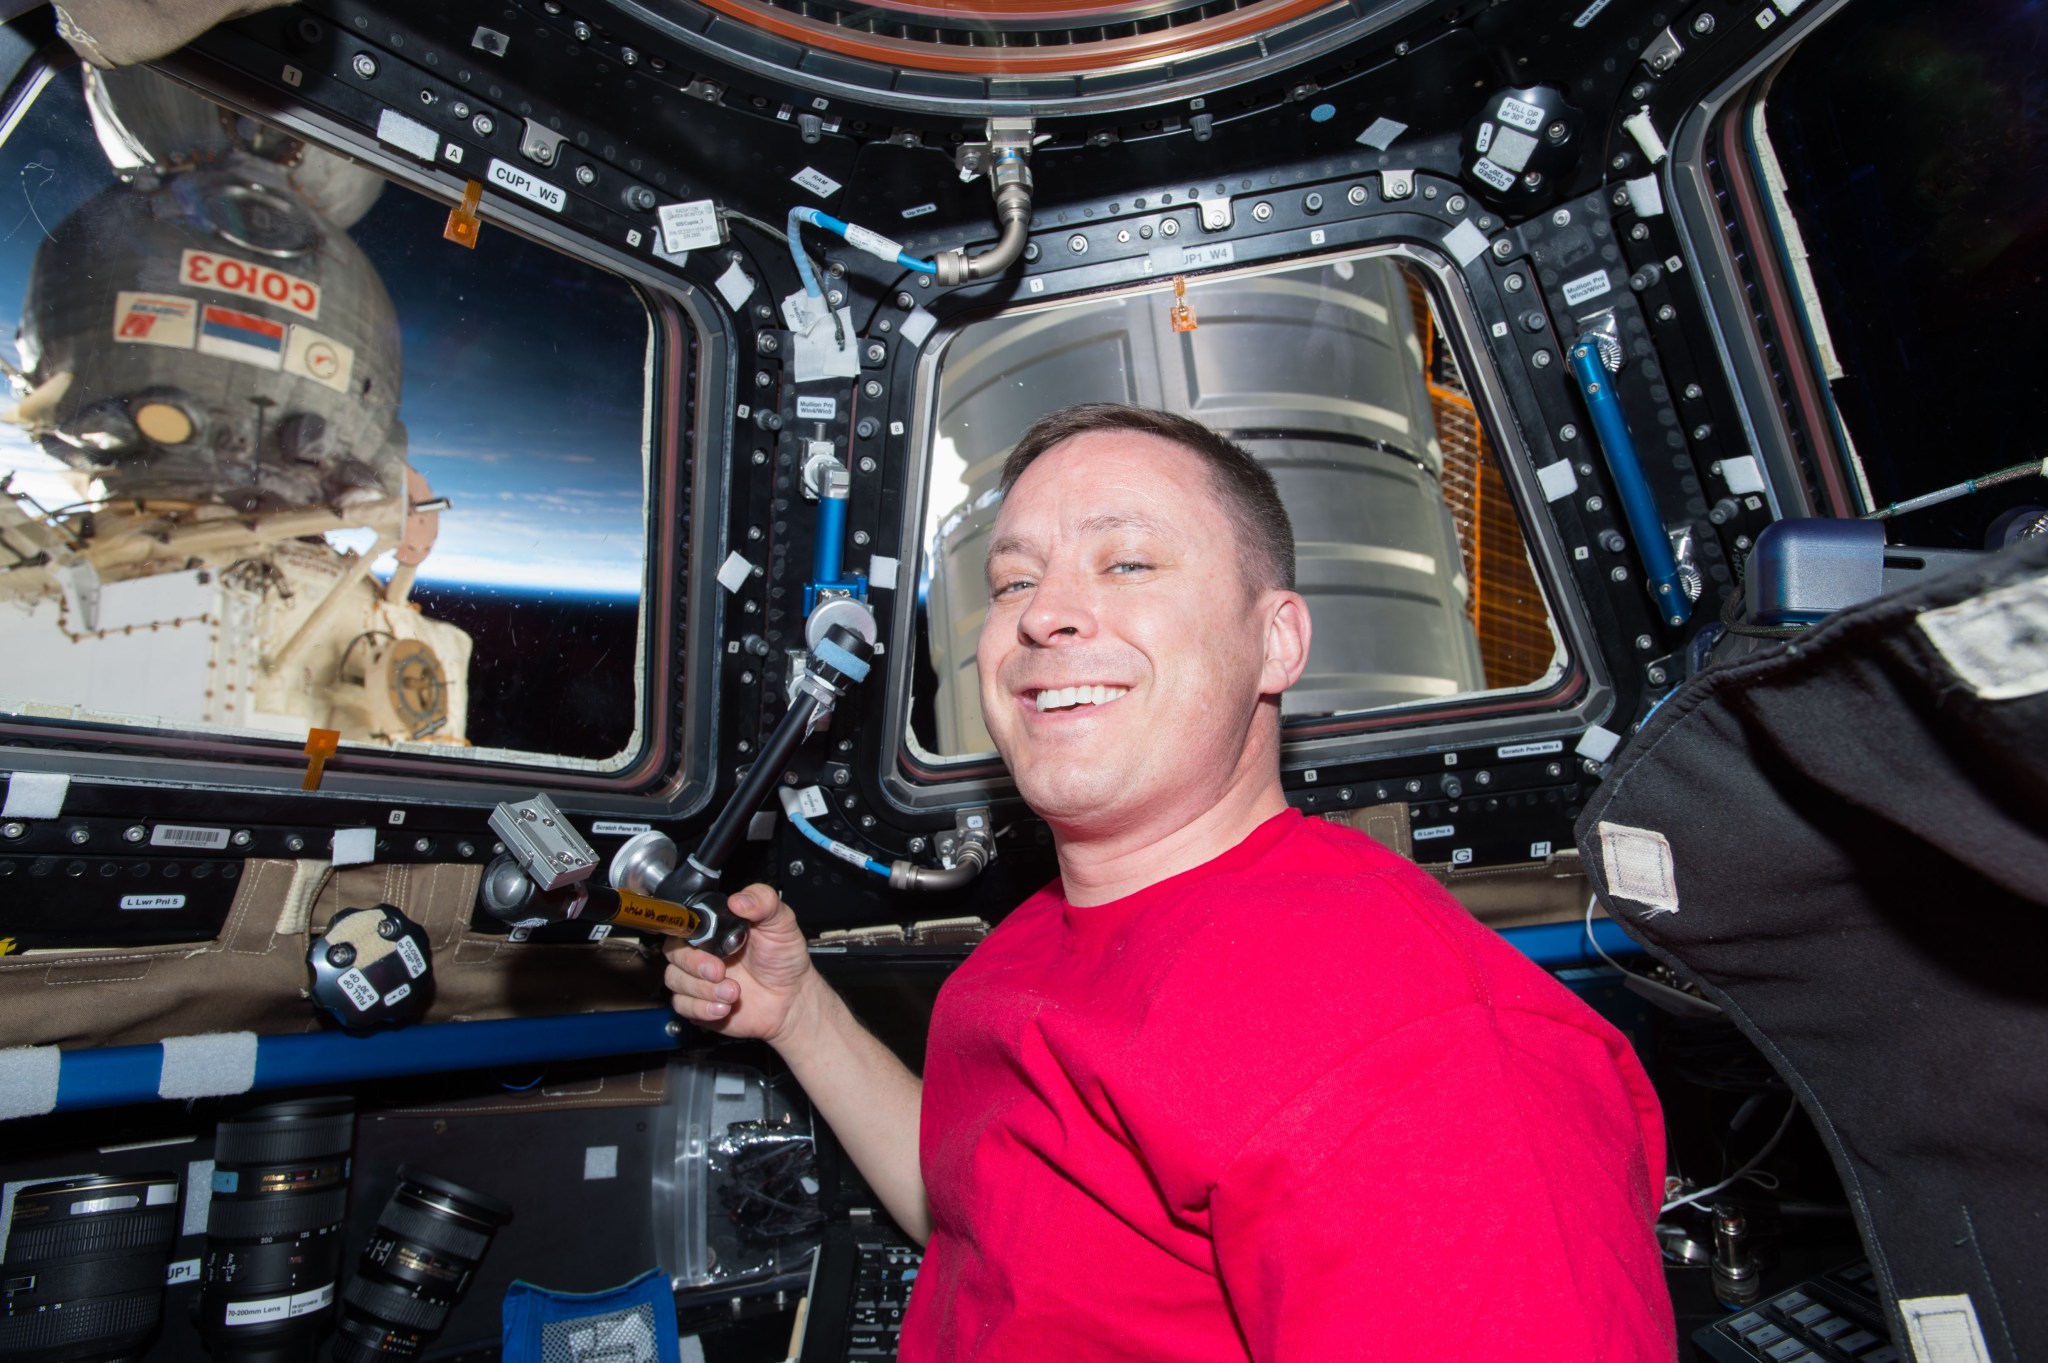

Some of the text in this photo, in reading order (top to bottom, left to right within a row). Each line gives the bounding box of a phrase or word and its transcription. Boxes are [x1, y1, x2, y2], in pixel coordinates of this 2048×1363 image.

[1578, 14, 1590, 23] Up
[288, 70, 296, 81] 1
[1507, 102, 1538, 118] FULL OP
[1524, 118, 1536, 126] OP
[1479, 139, 1486, 148] CL
[450, 148, 458, 159] A
[1478, 161, 1489, 170] OP
[812, 174, 828, 185] RAM
[1478, 168, 1505, 187] CLOSED
[495, 167, 560, 205] CUP1_W5
[798, 176, 828, 194] Cupola_2
[631, 234, 637, 242] 2
[1670, 260, 1678, 268] 8
[188, 254, 316, 312] СОЮЗ
[1566, 276, 1604, 294] Mullion Pnl
[1570, 282, 1606, 300] Win3/Win4
[1496, 326, 1502, 334] 3
[740, 407, 746, 416] 3
[1307, 772, 1314, 780] B
[392, 813, 401, 822] B
[1455, 844, 1548, 862] G H
[511, 925, 606, 940] G H
[405, 940, 423, 968] CLOSED
[412, 964, 420, 975] OP
[349, 973, 360, 983] OP
[343, 979, 367, 1006] FULL OP
[366, 992, 374, 1000] or
[398, 988, 408, 996] CL
[228, 1305, 281, 1317] 70-200mm Lens
